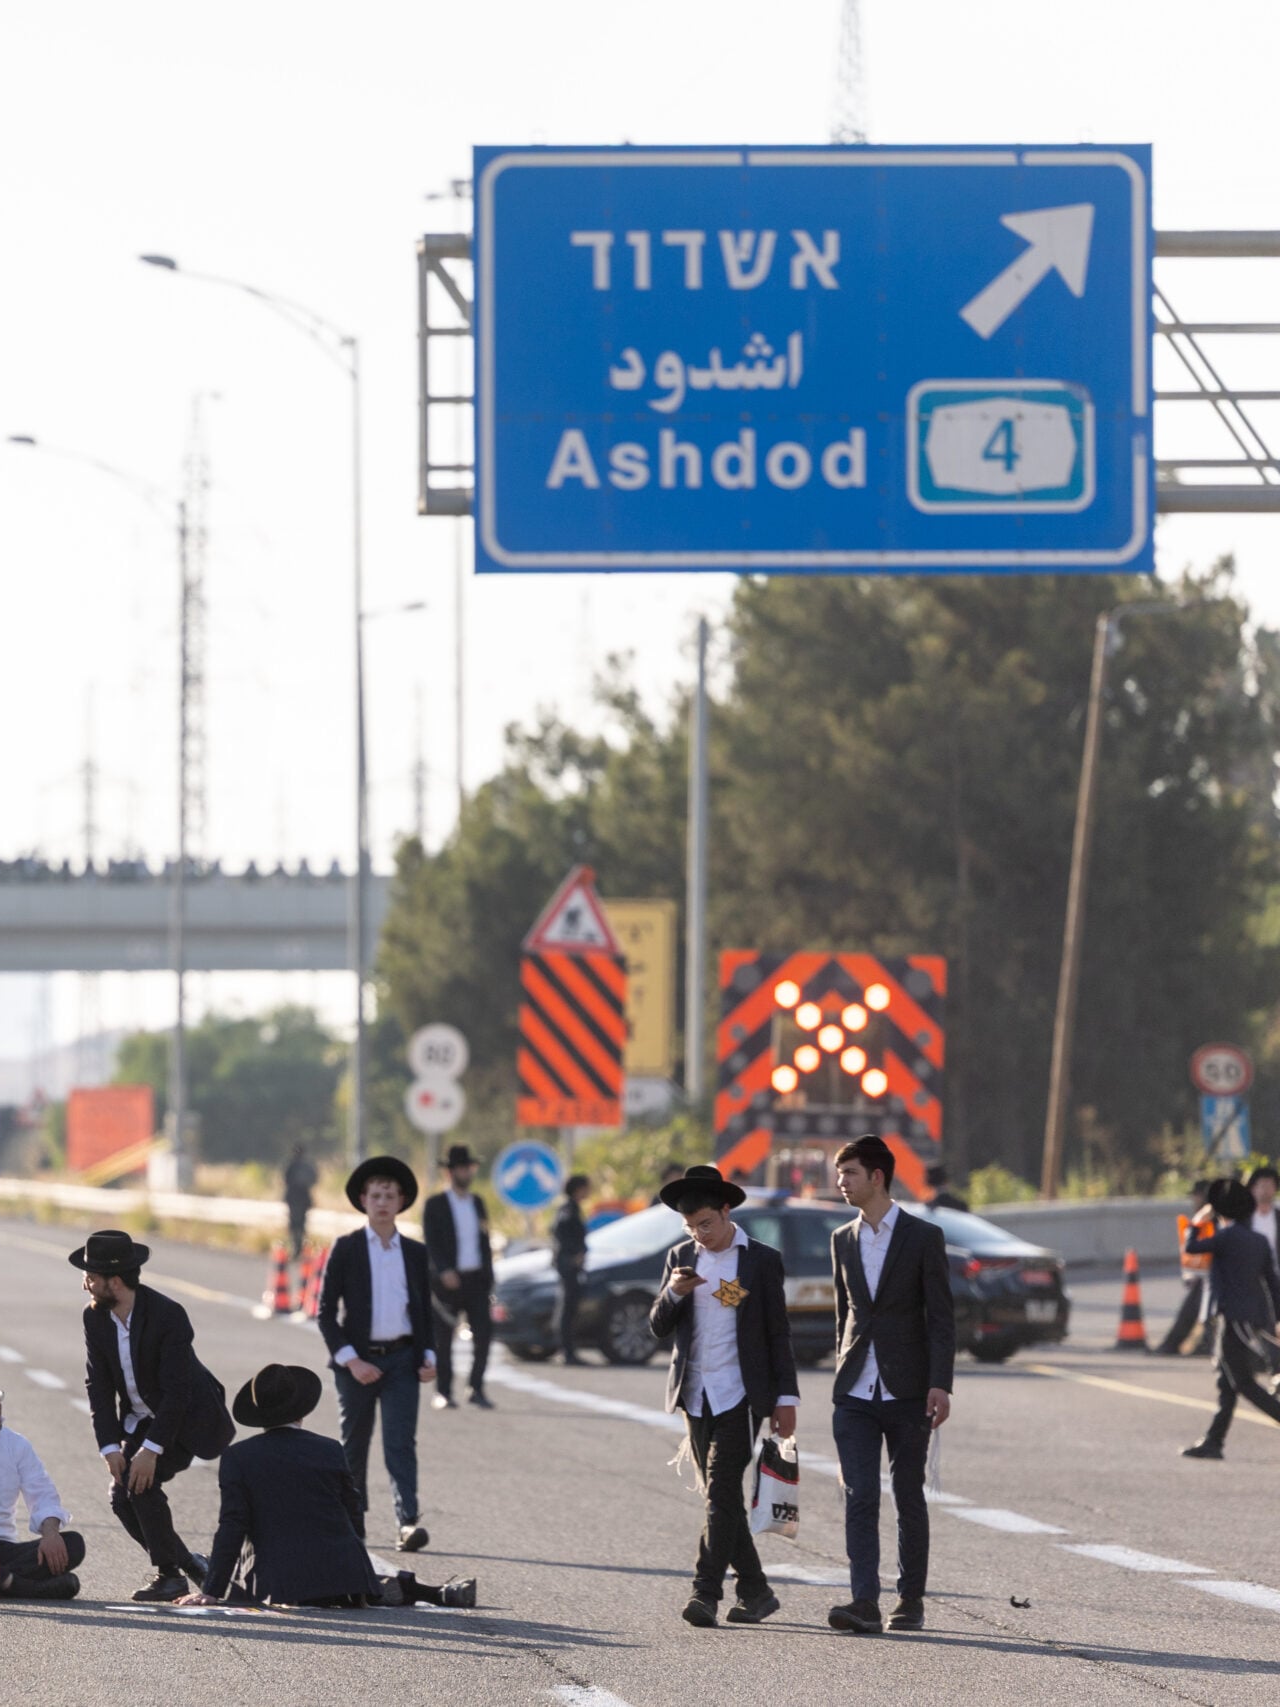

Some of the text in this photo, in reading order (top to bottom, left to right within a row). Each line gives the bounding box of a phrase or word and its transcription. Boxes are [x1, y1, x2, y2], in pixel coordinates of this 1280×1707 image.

[570, 230, 840, 290] אשדוד
[609, 331, 803, 412] اشدود
[547, 428, 868, 489] Ashdod
[981, 418, 1021, 473] 4
